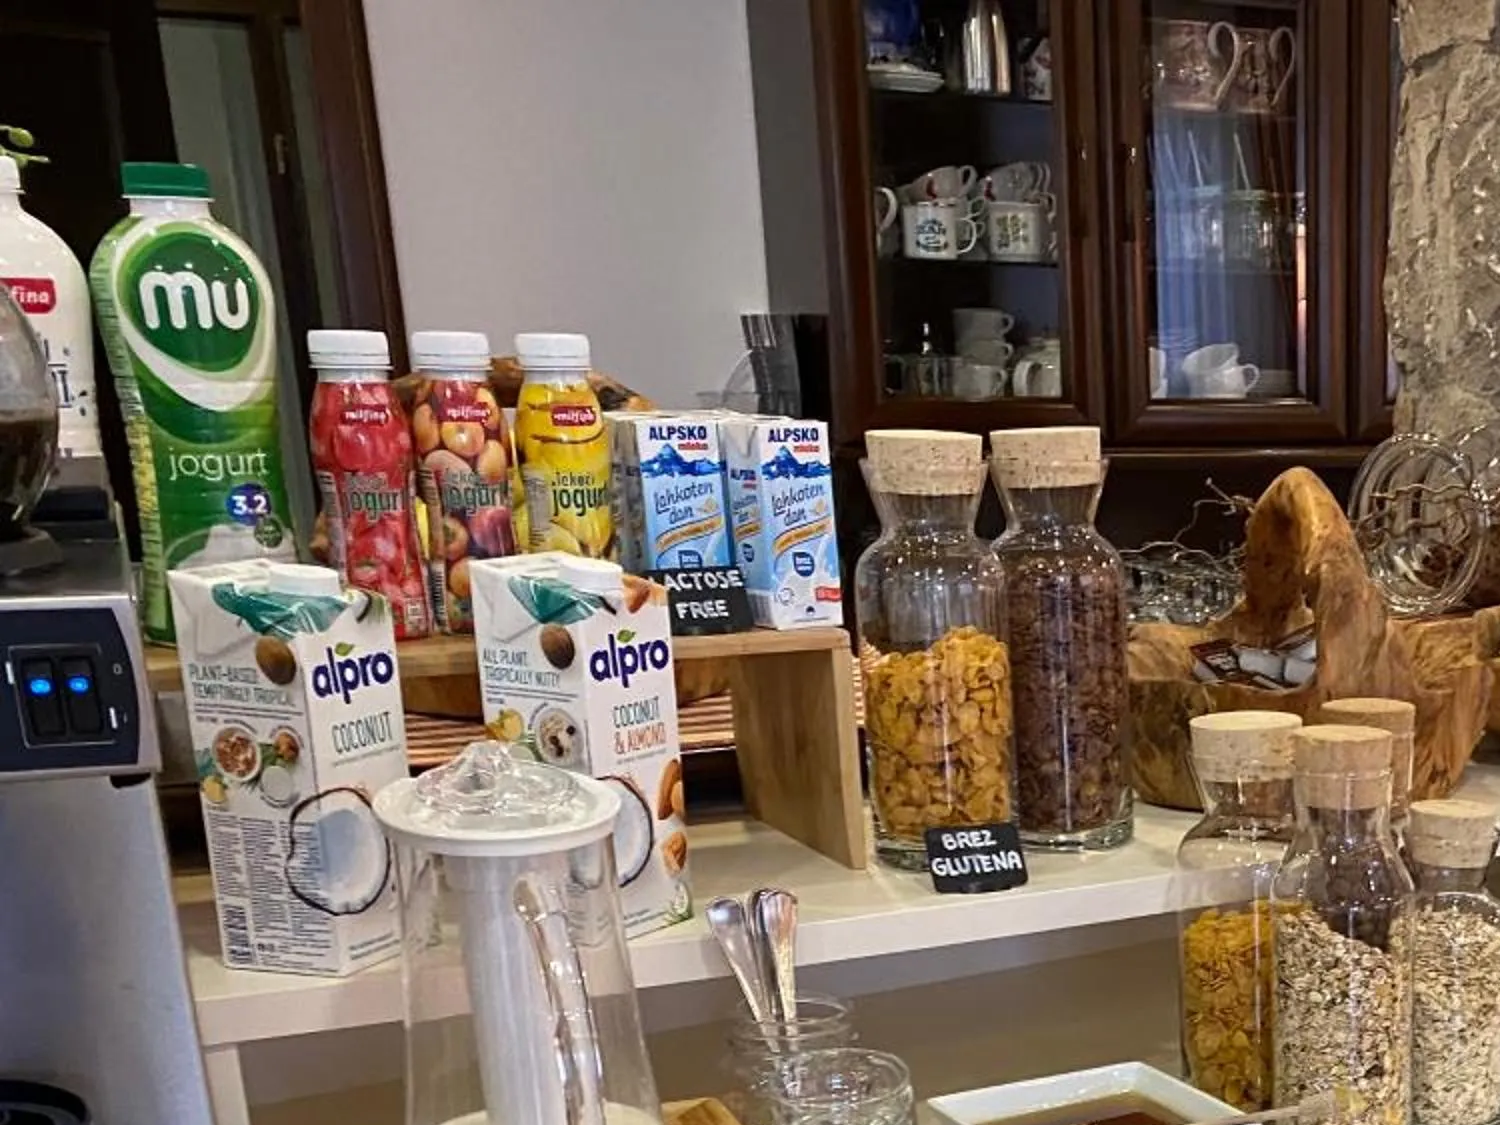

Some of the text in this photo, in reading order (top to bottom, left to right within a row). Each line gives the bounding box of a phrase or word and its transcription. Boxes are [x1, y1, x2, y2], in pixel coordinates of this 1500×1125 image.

[139, 271, 250, 330] mu
[649, 425, 708, 441] ALPSKO
[767, 427, 819, 443] ALPSKO
[169, 446, 270, 482] jogurt
[232, 493, 268, 515] 3.2
[669, 505, 694, 524] dan
[675, 600, 730, 620] FREE
[589, 633, 669, 689] alpro
[312, 646, 394, 705] alpro
[613, 695, 660, 728] COCONUT
[332, 711, 392, 755] COCONUT
[941, 829, 998, 851] BREZ
[931, 850, 1023, 877] GLUTENA
